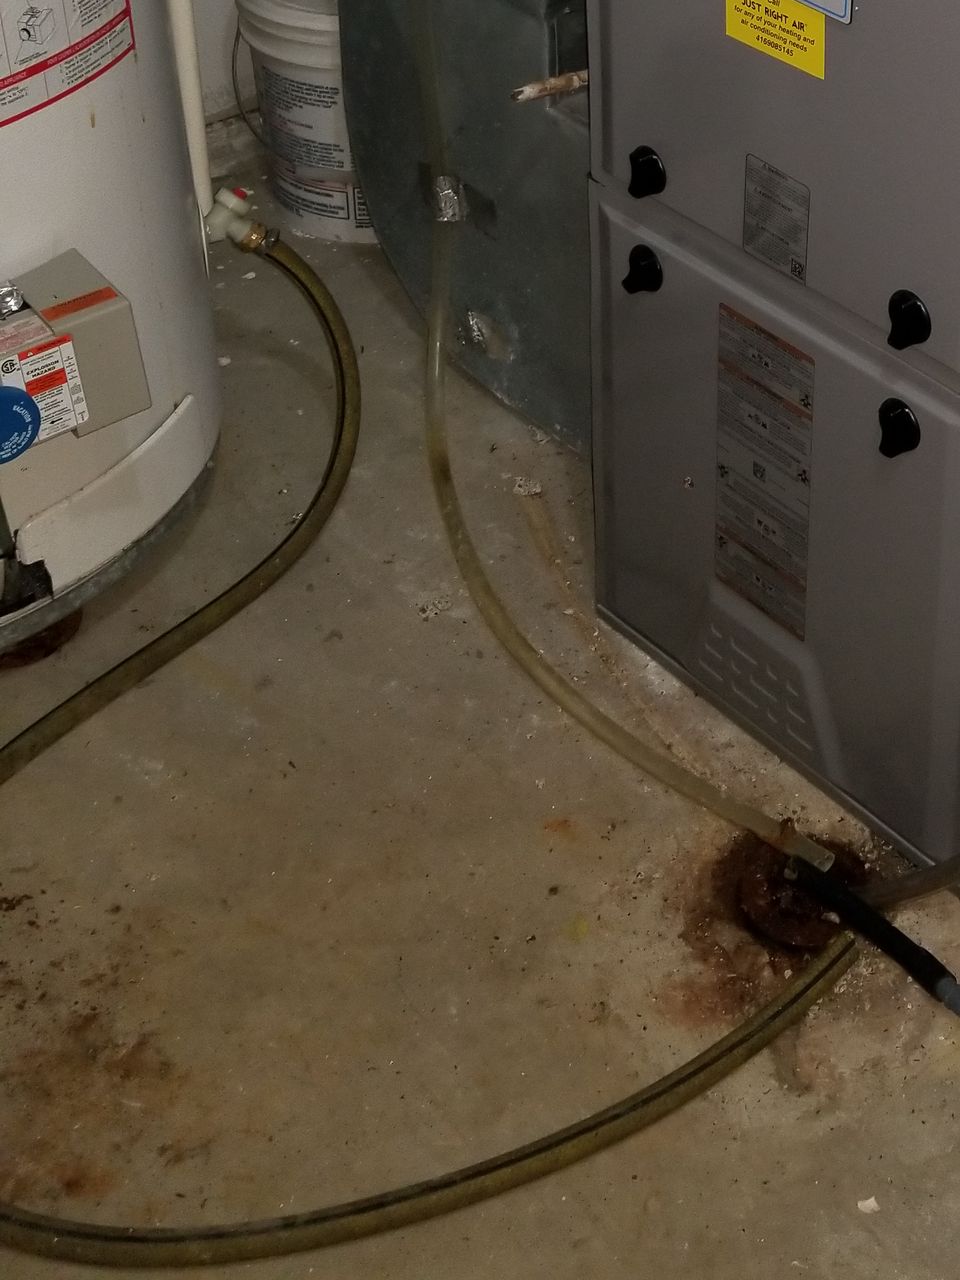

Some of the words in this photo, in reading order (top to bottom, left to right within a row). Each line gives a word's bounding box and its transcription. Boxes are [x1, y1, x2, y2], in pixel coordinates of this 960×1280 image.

[765, 7, 788, 24] RIGHT
[744, 11, 754, 19] any
[764, 19, 777, 28] your
[779, 25, 801, 40] heating
[803, 36, 815, 45] and
[750, 22, 787, 44] conditioning
[789, 40, 807, 52] needs
[26, 360, 59, 375] EXPLOSION
[32, 366, 55, 377] HAZARD
